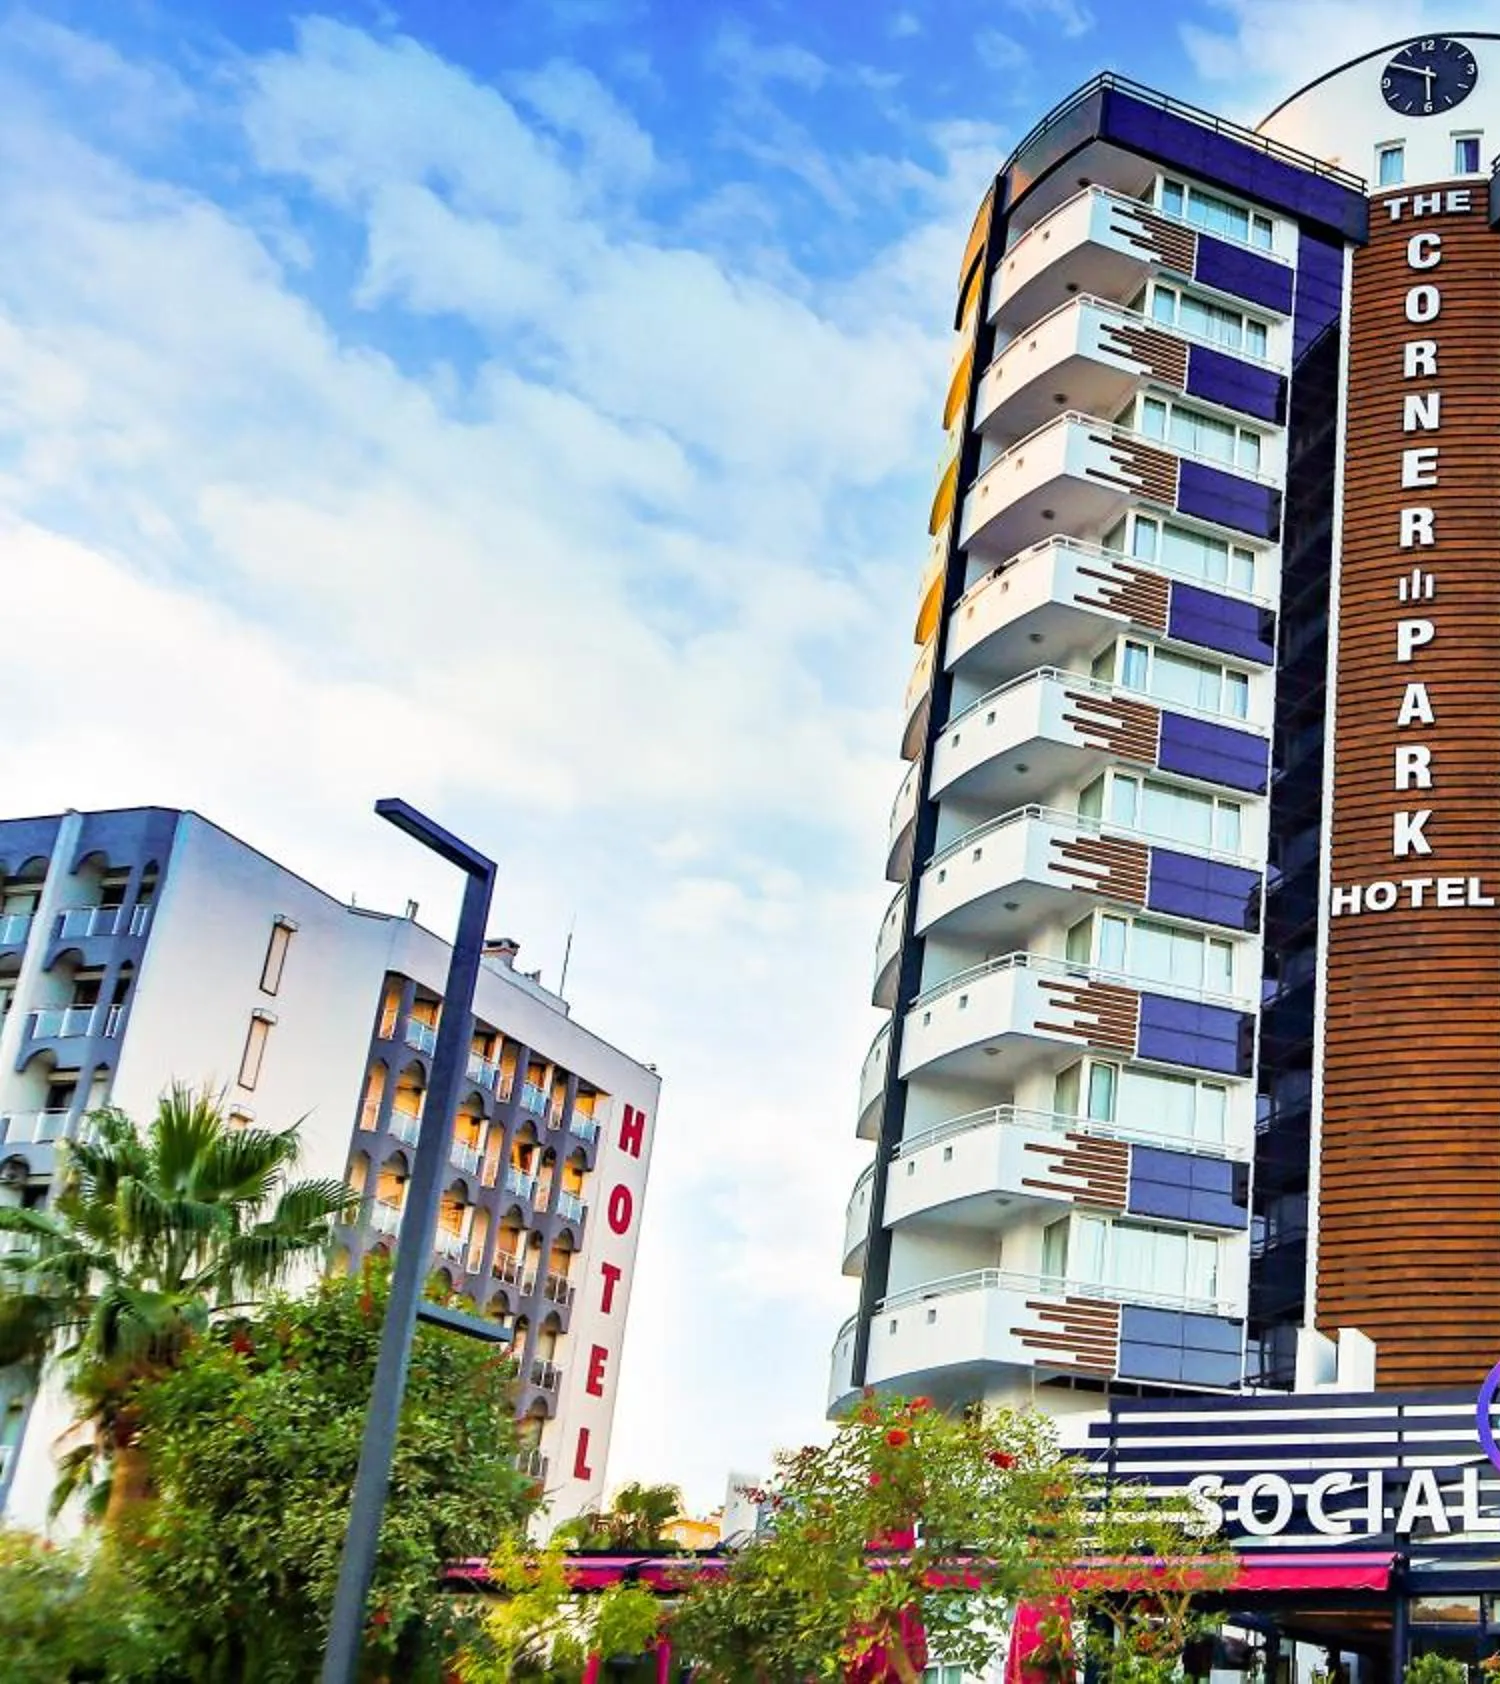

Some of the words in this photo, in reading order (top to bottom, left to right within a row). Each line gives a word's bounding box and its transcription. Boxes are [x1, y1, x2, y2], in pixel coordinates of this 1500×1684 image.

[1420, 38, 1435, 51] 12
[1382, 77, 1391, 89] 9
[1466, 63, 1475, 74] 3
[1423, 101, 1433, 113] 6
[1383, 189, 1472, 221] THE
[1400, 232, 1442, 548] CORNER
[1393, 618, 1436, 857] PARK
[1330, 876, 1496, 917] HOTEL
[573, 1103, 647, 1482] HOTEL
